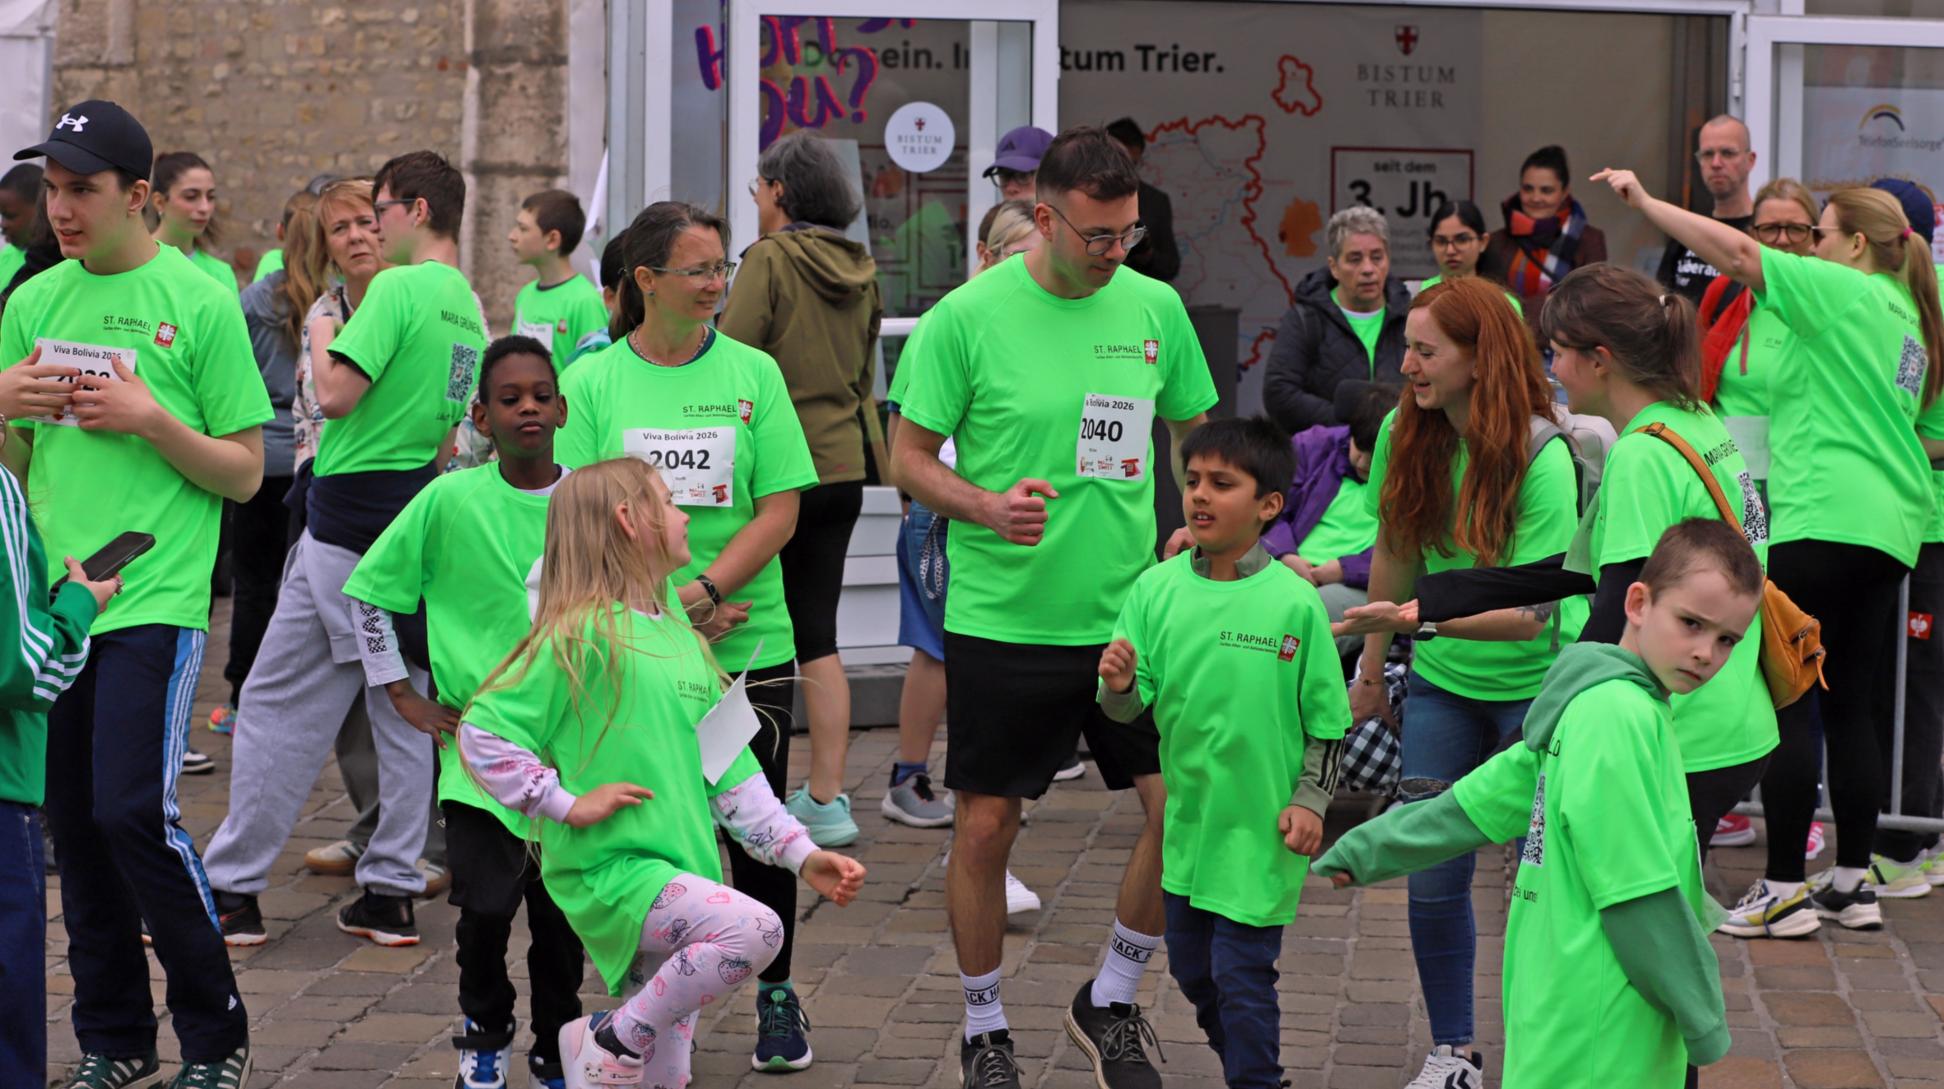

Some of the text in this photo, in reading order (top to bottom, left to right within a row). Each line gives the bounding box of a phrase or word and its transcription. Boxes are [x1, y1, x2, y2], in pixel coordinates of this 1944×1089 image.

[1134, 44, 1225, 72] Trier.
[1357, 63, 1456, 83] BISTUM
[1366, 89, 1445, 108] TRIER
[897, 135, 942, 143] BISTUM
[902, 146, 937, 154] TRIER
[1374, 159, 1437, 173] seit dem
[103, 315, 116, 326] ST.
[118, 316, 152, 333] RAPHAEL
[53, 345, 71, 355] Viva
[72, 347, 100, 359] Bolivia
[1094, 345, 1143, 355] ST. RAPHAEL
[682, 404, 738, 414] ST. RAPHAEL
[1112, 400, 1135, 411] 2026
[643, 431, 718, 441] Viva Bolivia 2026
[1081, 417, 1123, 442] 2040
[649, 448, 711, 470] 2042
[1219, 631, 1234, 641] ST.
[1236, 633, 1279, 648] RAPHAEL
[1112, 936, 1143, 960] HACK
